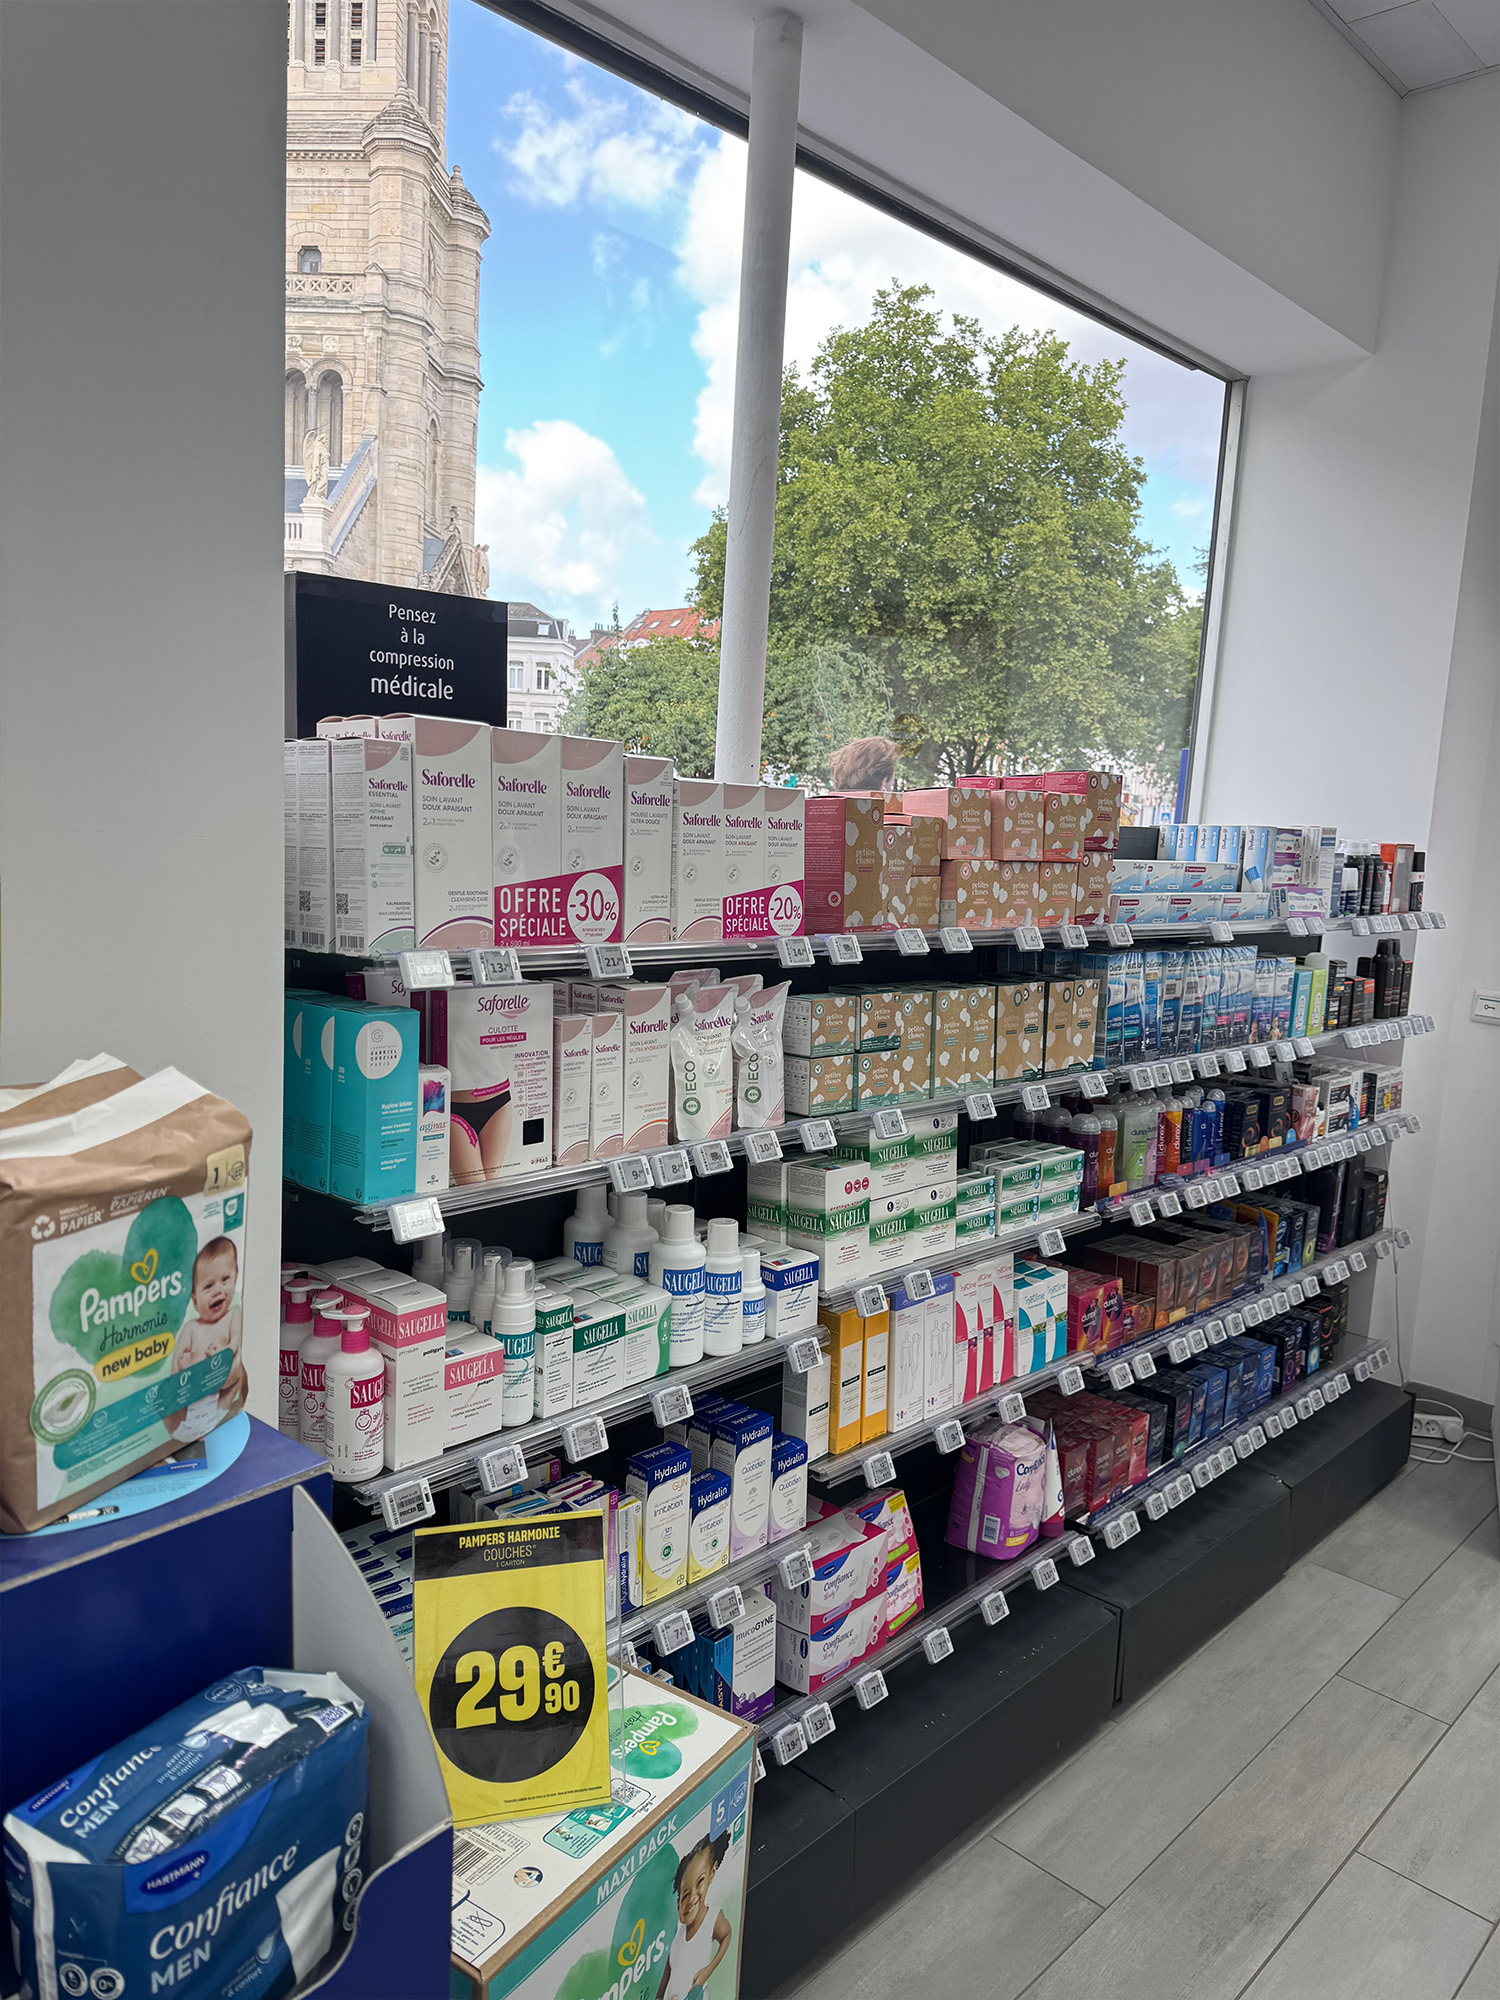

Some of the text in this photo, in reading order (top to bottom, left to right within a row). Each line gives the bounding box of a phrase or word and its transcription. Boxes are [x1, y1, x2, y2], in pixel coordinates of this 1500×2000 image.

[389, 603, 436, 625] Pensez
[400, 628, 425, 645] à la
[369, 650, 455, 671] compression
[371, 675, 454, 700] médicale
[369, 778, 408, 791] Saforelle
[422, 768, 476, 789] Saforelle
[498, 775, 547, 794] Saforelle
[422, 795, 437, 803] SOIN
[566, 781, 611, 799] Saforelle
[631, 790, 670, 807] Saforelle
[683, 811, 721, 827] Saforelle
[725, 814, 762, 829] Saforelle
[768, 816, 803, 831] Saforelle
[856, 848, 875, 858] petites
[856, 857, 875, 865] choses
[888, 857, 905, 866] petites
[500, 888, 561, 913] OFFRE
[569, 889, 617, 922] -30%
[726, 897, 765, 915] OFFRE
[770, 897, 801, 921] -20%
[500, 913, 566, 937] SPÉCIALE
[726, 915, 768, 933] SPÉCIALE
[573, 989, 595, 1001] Saforelle
[600, 993, 624, 1004] Saforelle
[477, 994, 529, 1015] Saforelle
[488, 1025, 518, 1034] CULOTTE
[630, 1020, 668, 1035] Saforelle
[695, 1016, 732, 1032] Saforelle
[907, 1025, 925, 1034] petites
[943, 1021, 960, 1029] petites
[506, 1033, 524, 1042] RÈGLES
[514, 1050, 549, 1059] INNOVATION
[564, 1049, 589, 1058] Saforelle
[595, 1044, 620, 1054] Saforelle
[684, 1060, 697, 1091] ECO
[748, 1053, 759, 1081] ECO
[878, 1145, 908, 1162] SAUGELLA
[922, 1136, 951, 1153] SAUGELLA
[213, 1166, 219, 1184] 1
[1054, 1161, 1073, 1173] SAUGELLA
[1012, 1170, 1032, 1183] SAUGELLA
[110, 1188, 167, 1211] PAPIEREN
[966, 1185, 986, 1197] SAUGELLA
[747, 1205, 780, 1223] SAUGELLA
[919, 1207, 949, 1225] SAUGELLA
[1010, 1203, 1030, 1216] SAUGELLA
[60, 1211, 102, 1234] PAPIER
[789, 1213, 824, 1232] SAUGELLA
[830, 1206, 866, 1232] SAUGELLA
[965, 1217, 986, 1229] SAUGELLA
[876, 1220, 907, 1238] SAUGELLA
[664, 1269, 705, 1292] SAUGELL
[705, 1275, 742, 1291] AUGELLA
[784, 1267, 813, 1286] SAUGELLA
[80, 1270, 182, 1332] Pampers
[1103, 1297, 1118, 1309] durex
[546, 1311, 573, 1329] SAUGELLA
[628, 1304, 658, 1324] SAUGELLA
[1081, 1311, 1098, 1323] durex
[100, 1311, 168, 1350] Harmonie
[366, 1313, 397, 1340] SAUGELLA
[399, 1312, 445, 1340] SAUGELLA
[583, 1320, 619, 1346] SAUGELLA
[422, 1347, 444, 1357] poligyn
[504, 1335, 535, 1356] AUGELL
[102, 1338, 170, 1379] new baby
[450, 1358, 494, 1385] SAUGELLA
[477, 1378, 494, 1387] poligyn
[741, 1425, 770, 1445] Hydralin
[714, 1446, 734, 1459] Quotidien
[628, 1464, 647, 1478] Hydralin
[741, 1459, 766, 1475] Quotidien
[777, 1452, 805, 1472] Hydralin
[1067, 1463, 1083, 1477] durex
[654, 1460, 687, 1483] Hydralin
[778, 1476, 802, 1491] Quotidien
[1015, 1478, 1030, 1493] Lady
[697, 1487, 728, 1508] Hydralin
[400, 1507, 417, 1517] PRICER
[653, 1500, 684, 1516] Irritation
[700, 1518, 723, 1534] Irritation
[459, 1526, 560, 1549] PAMPERS HARMONIE
[501, 1559, 525, 1567] CARTON
[824, 1570, 854, 1592] Confiance
[824, 1586, 839, 1600] Lady
[736, 1614, 774, 1642] mucoGYNE
[822, 1628, 853, 1652] Confiance
[822, 1646, 838, 1661] Lady
[455, 1641, 580, 1730] 29 € 90
[610, 1710, 677, 1759] Pampers
[166, 1750, 186, 1767] extra
[178, 1754, 203, 1777] confort
[157, 1752, 194, 1784] protection
[60, 1744, 162, 1829] Confiance
[75, 1801, 119, 1839] MEN
[716, 1799, 725, 1823] 5
[596, 1858, 635, 1905] MAXI
[638, 1815, 678, 1864] PACK
[147, 1855, 205, 1890] HARTMANN
[149, 1844, 297, 1960] Confiance
[150, 1942, 211, 1994] MEN
[236, 1967, 263, 1990] confort
